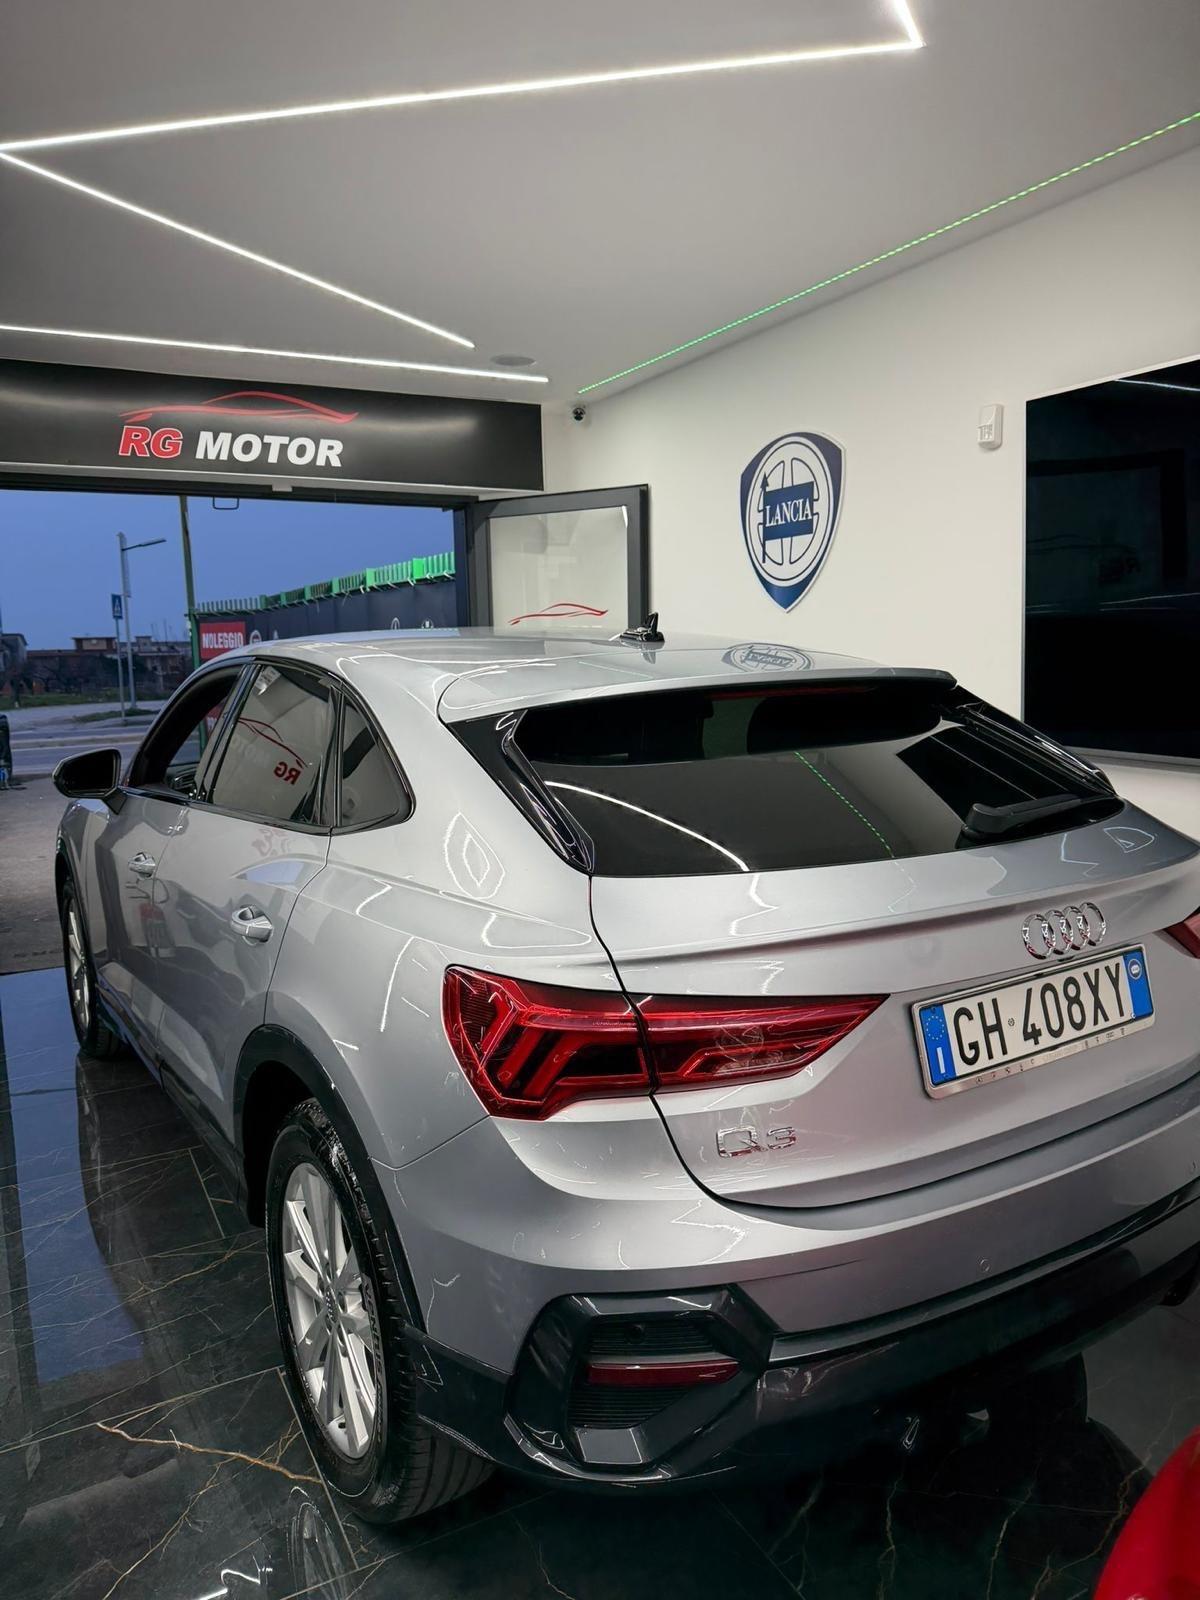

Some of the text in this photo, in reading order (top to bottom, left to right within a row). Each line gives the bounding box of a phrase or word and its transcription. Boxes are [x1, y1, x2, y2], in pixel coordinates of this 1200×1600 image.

[118, 425, 344, 467] RG MOTOR
[765, 498, 812, 527] LANCIA
[202, 632, 244, 650] NOLEGGIO
[953, 997, 1008, 1066] GH
[1022, 962, 1124, 1045] 408XY
[716, 1126, 797, 1158] Q3
